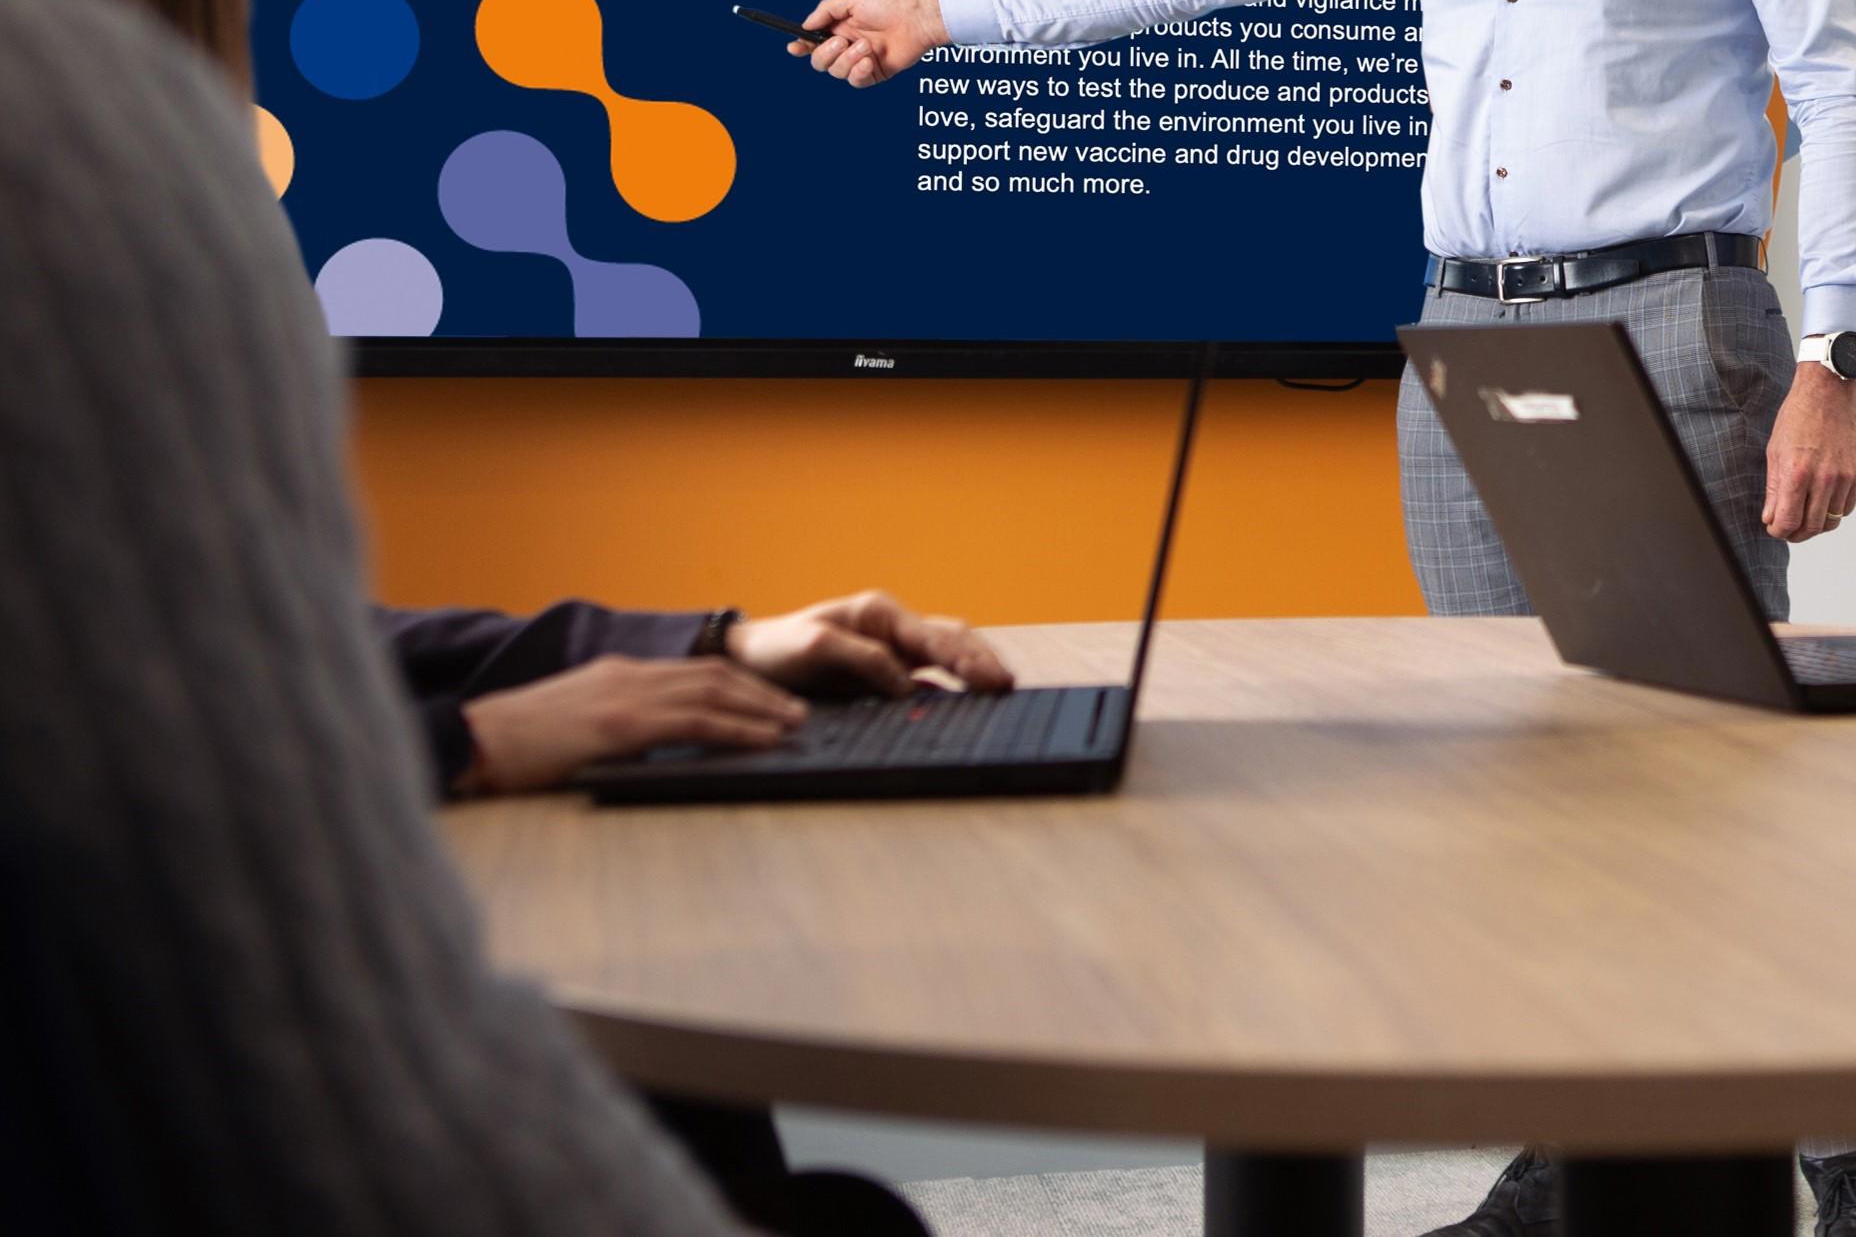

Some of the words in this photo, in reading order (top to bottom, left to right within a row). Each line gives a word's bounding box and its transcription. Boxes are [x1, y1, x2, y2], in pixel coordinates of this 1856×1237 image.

[1240, 22, 1281, 42] you
[1291, 24, 1395, 41] consume
[920, 46, 1070, 66] environment
[1078, 49, 1120, 72] you
[1130, 47, 1169, 68] live
[1178, 48, 1204, 69] in.
[1211, 49, 1239, 69] All
[1248, 50, 1284, 70] the
[1292, 51, 1348, 75] time,
[1357, 53, 1418, 73] we’re
[920, 78, 970, 95] new
[977, 79, 1039, 101] ways
[1047, 77, 1069, 96] to
[1078, 77, 1121, 98] test
[1129, 78, 1165, 98] the
[1175, 80, 1269, 104] produce
[1277, 82, 1320, 102] and
[1330, 83, 1428, 107] products
[919, 106, 975, 130] love,
[985, 108, 1105, 134] safeguard
[1113, 110, 1151, 130] the
[1159, 112, 1305, 135] environment
[1313, 119, 1353, 139] you
[1363, 115, 1400, 135] live
[918, 142, 1010, 166] support
[1019, 146, 1067, 162] new
[1075, 144, 1166, 164] vaccine
[1175, 144, 1218, 165] and
[1227, 145, 1279, 170] drug
[918, 171, 962, 192] and
[972, 176, 999, 193] so
[1010, 173, 1074, 194] much
[1084, 178, 1150, 195] more.
